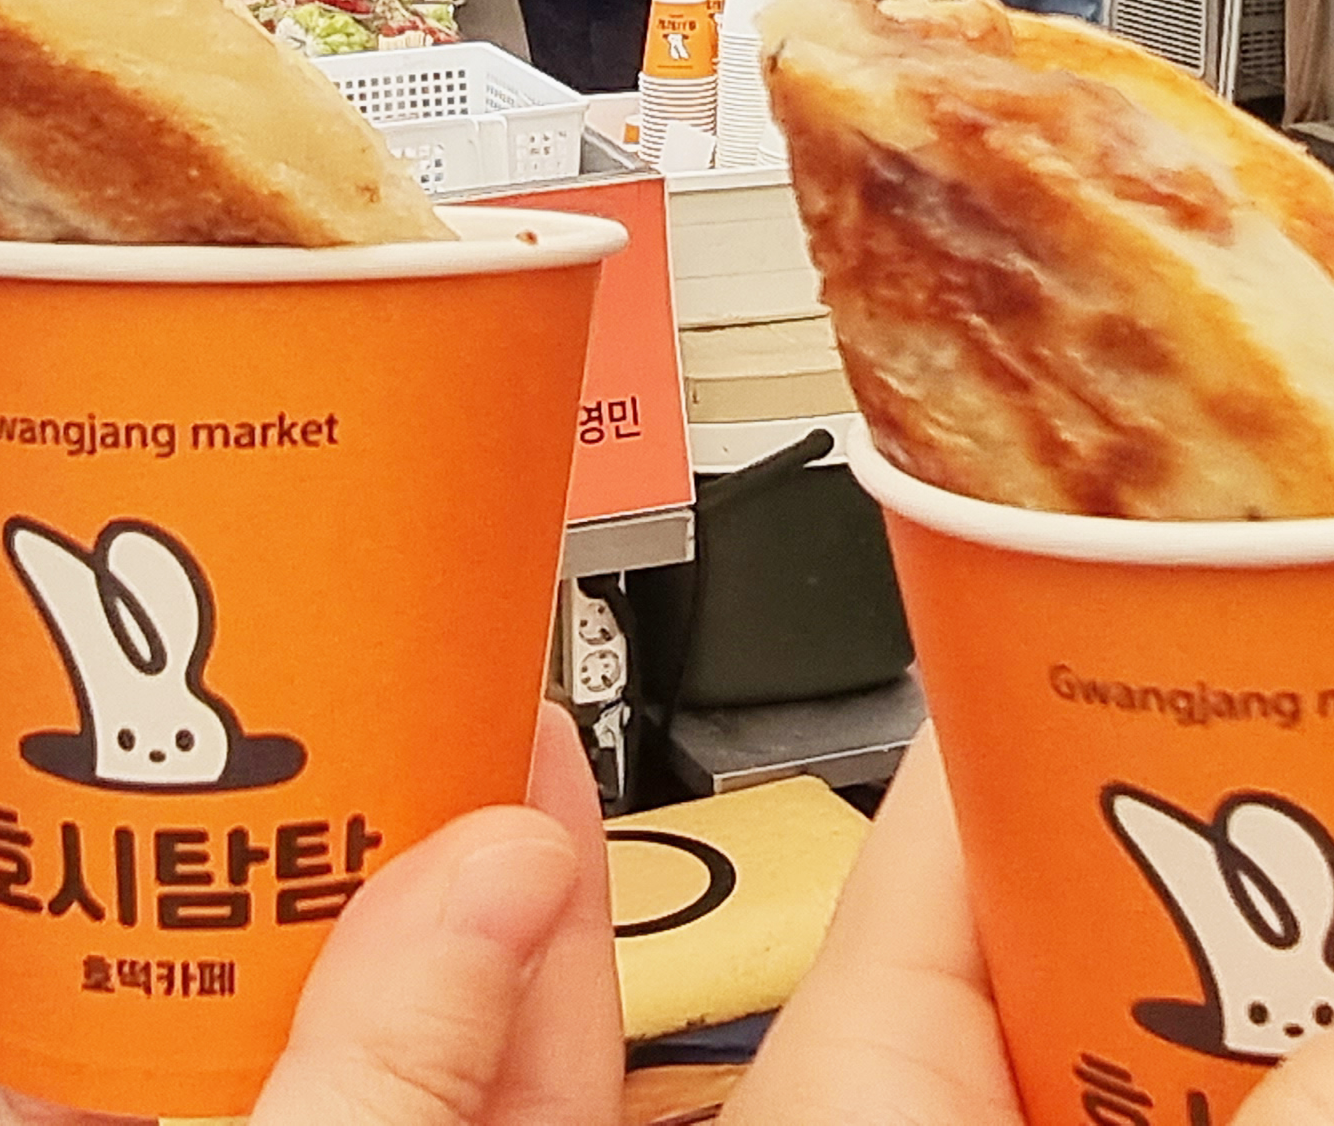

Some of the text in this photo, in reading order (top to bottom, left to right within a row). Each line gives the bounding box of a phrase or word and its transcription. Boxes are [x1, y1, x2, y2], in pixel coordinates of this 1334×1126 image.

[190, 411, 340, 451] market
[1048, 663, 1302, 729] Gwangjang
[82, 954, 237, 999] 호떡카페
